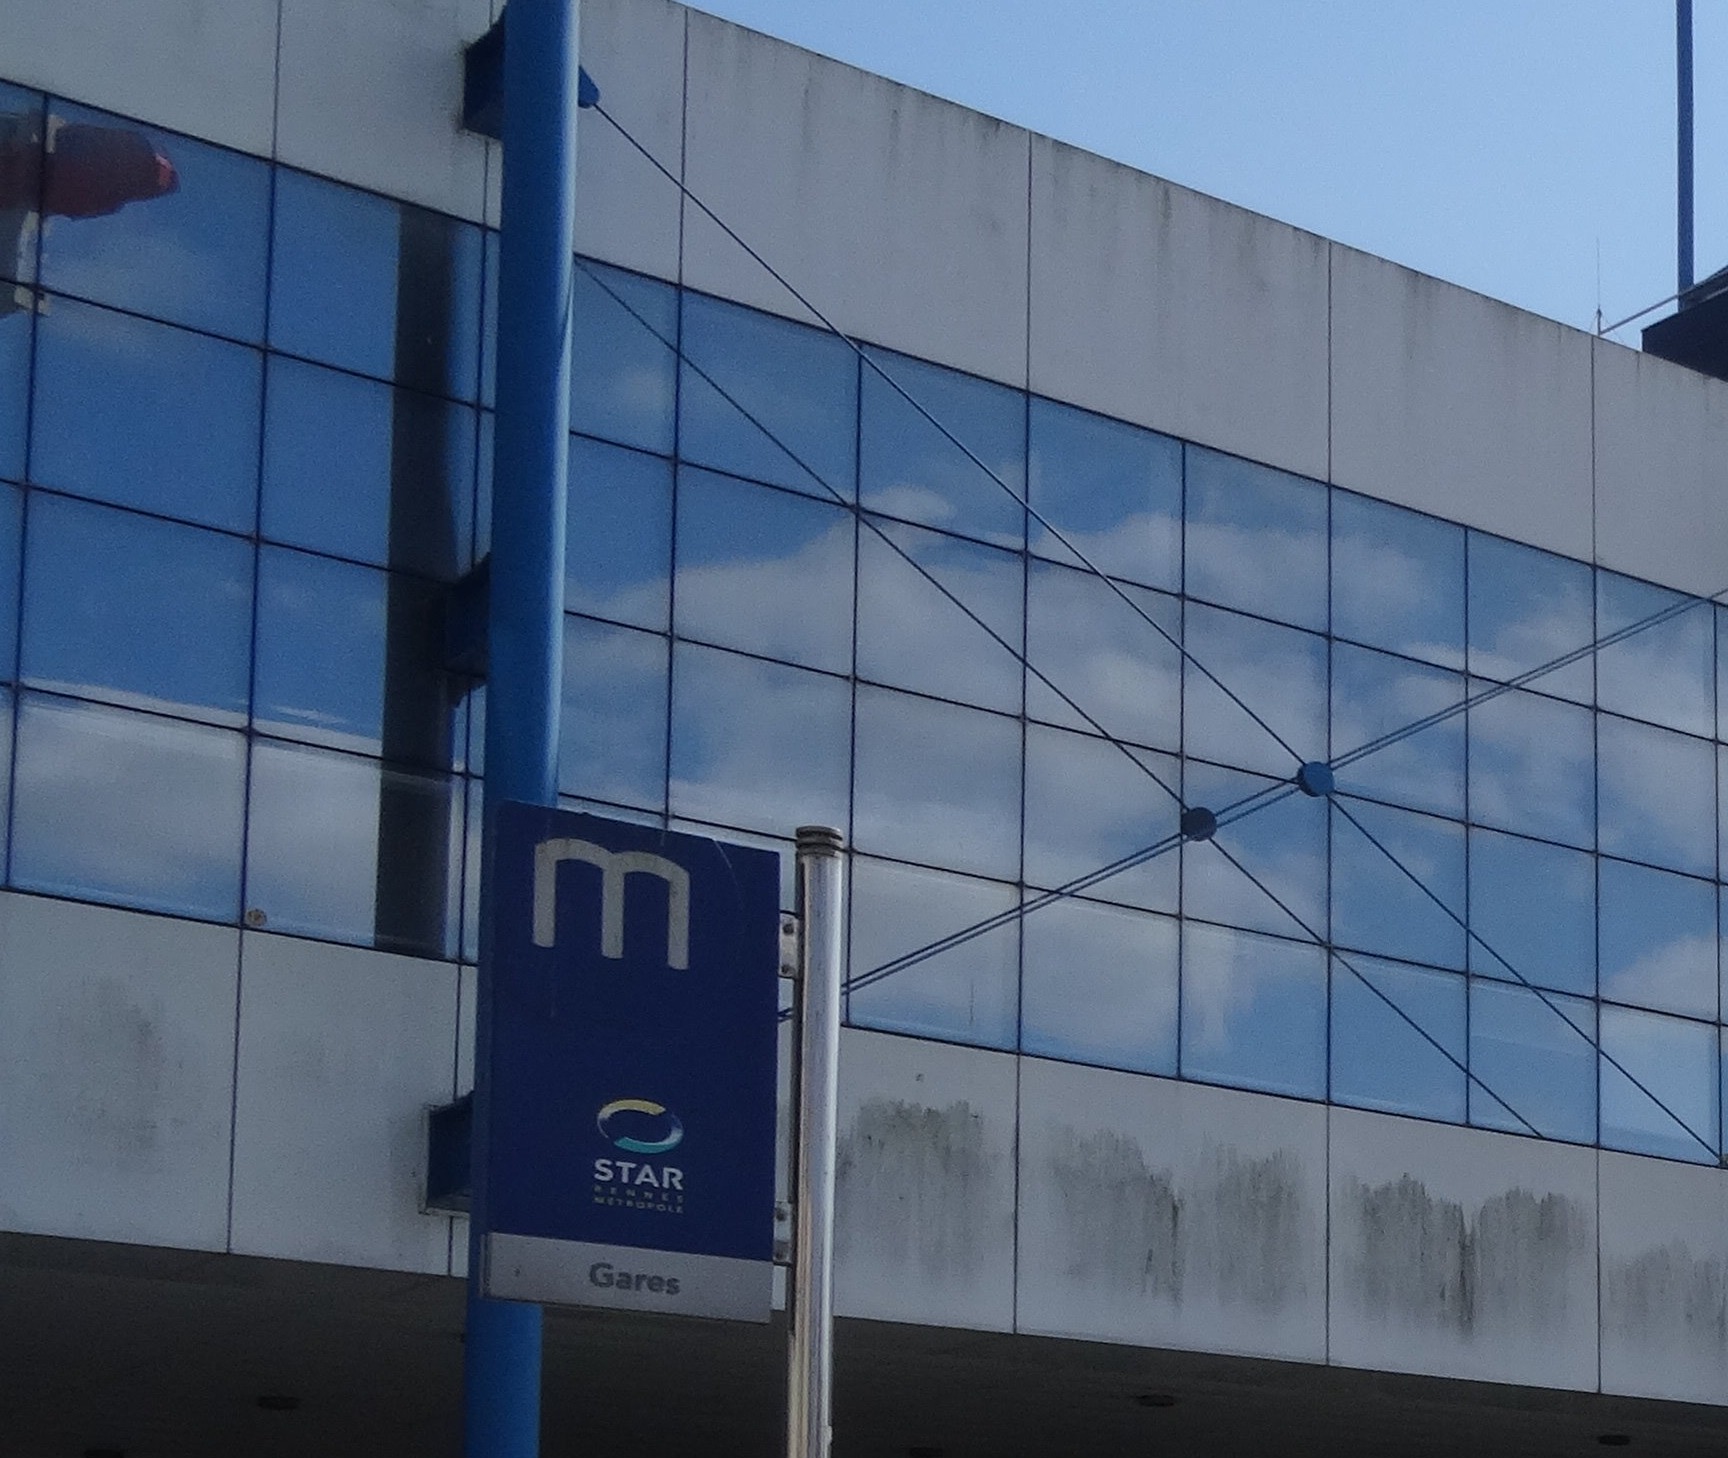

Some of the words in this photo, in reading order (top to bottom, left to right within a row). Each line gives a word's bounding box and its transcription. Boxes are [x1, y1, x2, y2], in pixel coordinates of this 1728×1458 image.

[531, 837, 691, 970] m
[593, 1157, 684, 1191] STAR
[589, 1262, 681, 1295] Gares
